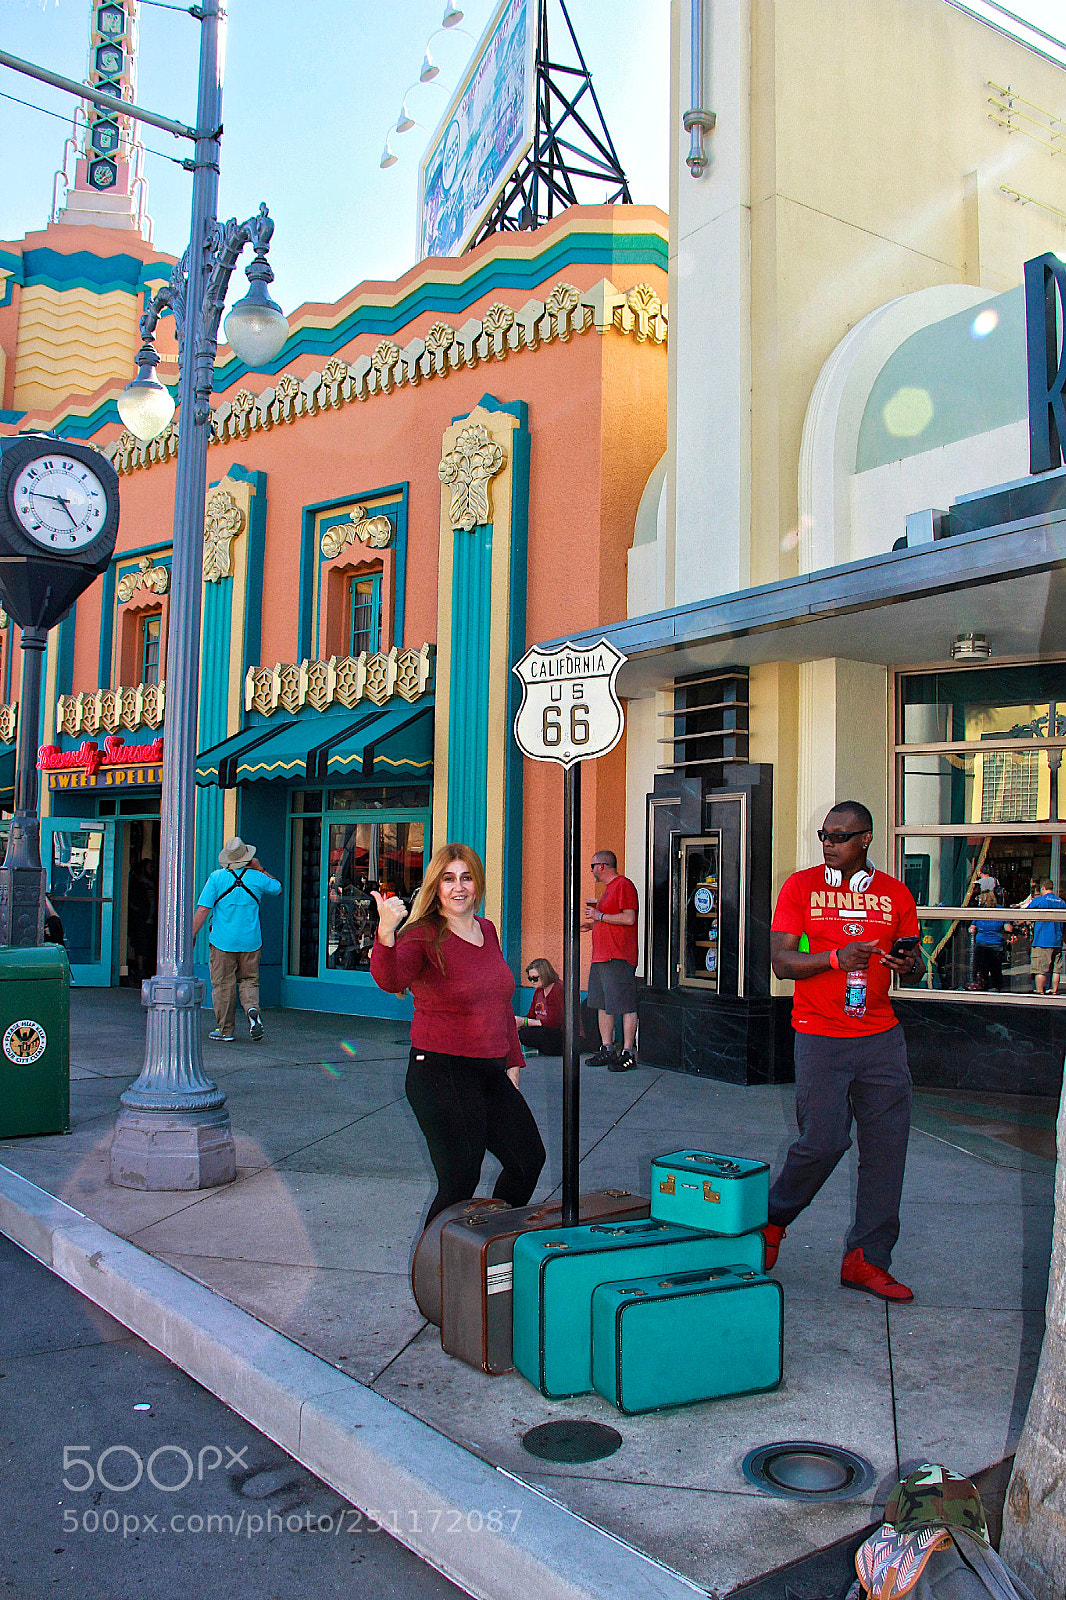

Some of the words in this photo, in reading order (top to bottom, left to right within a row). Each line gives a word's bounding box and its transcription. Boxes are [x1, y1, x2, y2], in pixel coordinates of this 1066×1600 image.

[27, 468, 38, 479] 10
[43, 461, 54, 470] 11
[62, 462, 73, 470] 12
[531, 655, 605, 677] CALIFORNIA
[543, 704, 589, 747] 66
[36, 741, 99, 777] Beverly
[101, 735, 162, 765] Sunset
[50, 774, 97, 788] SWEET
[811, 891, 893, 913] NINERS
